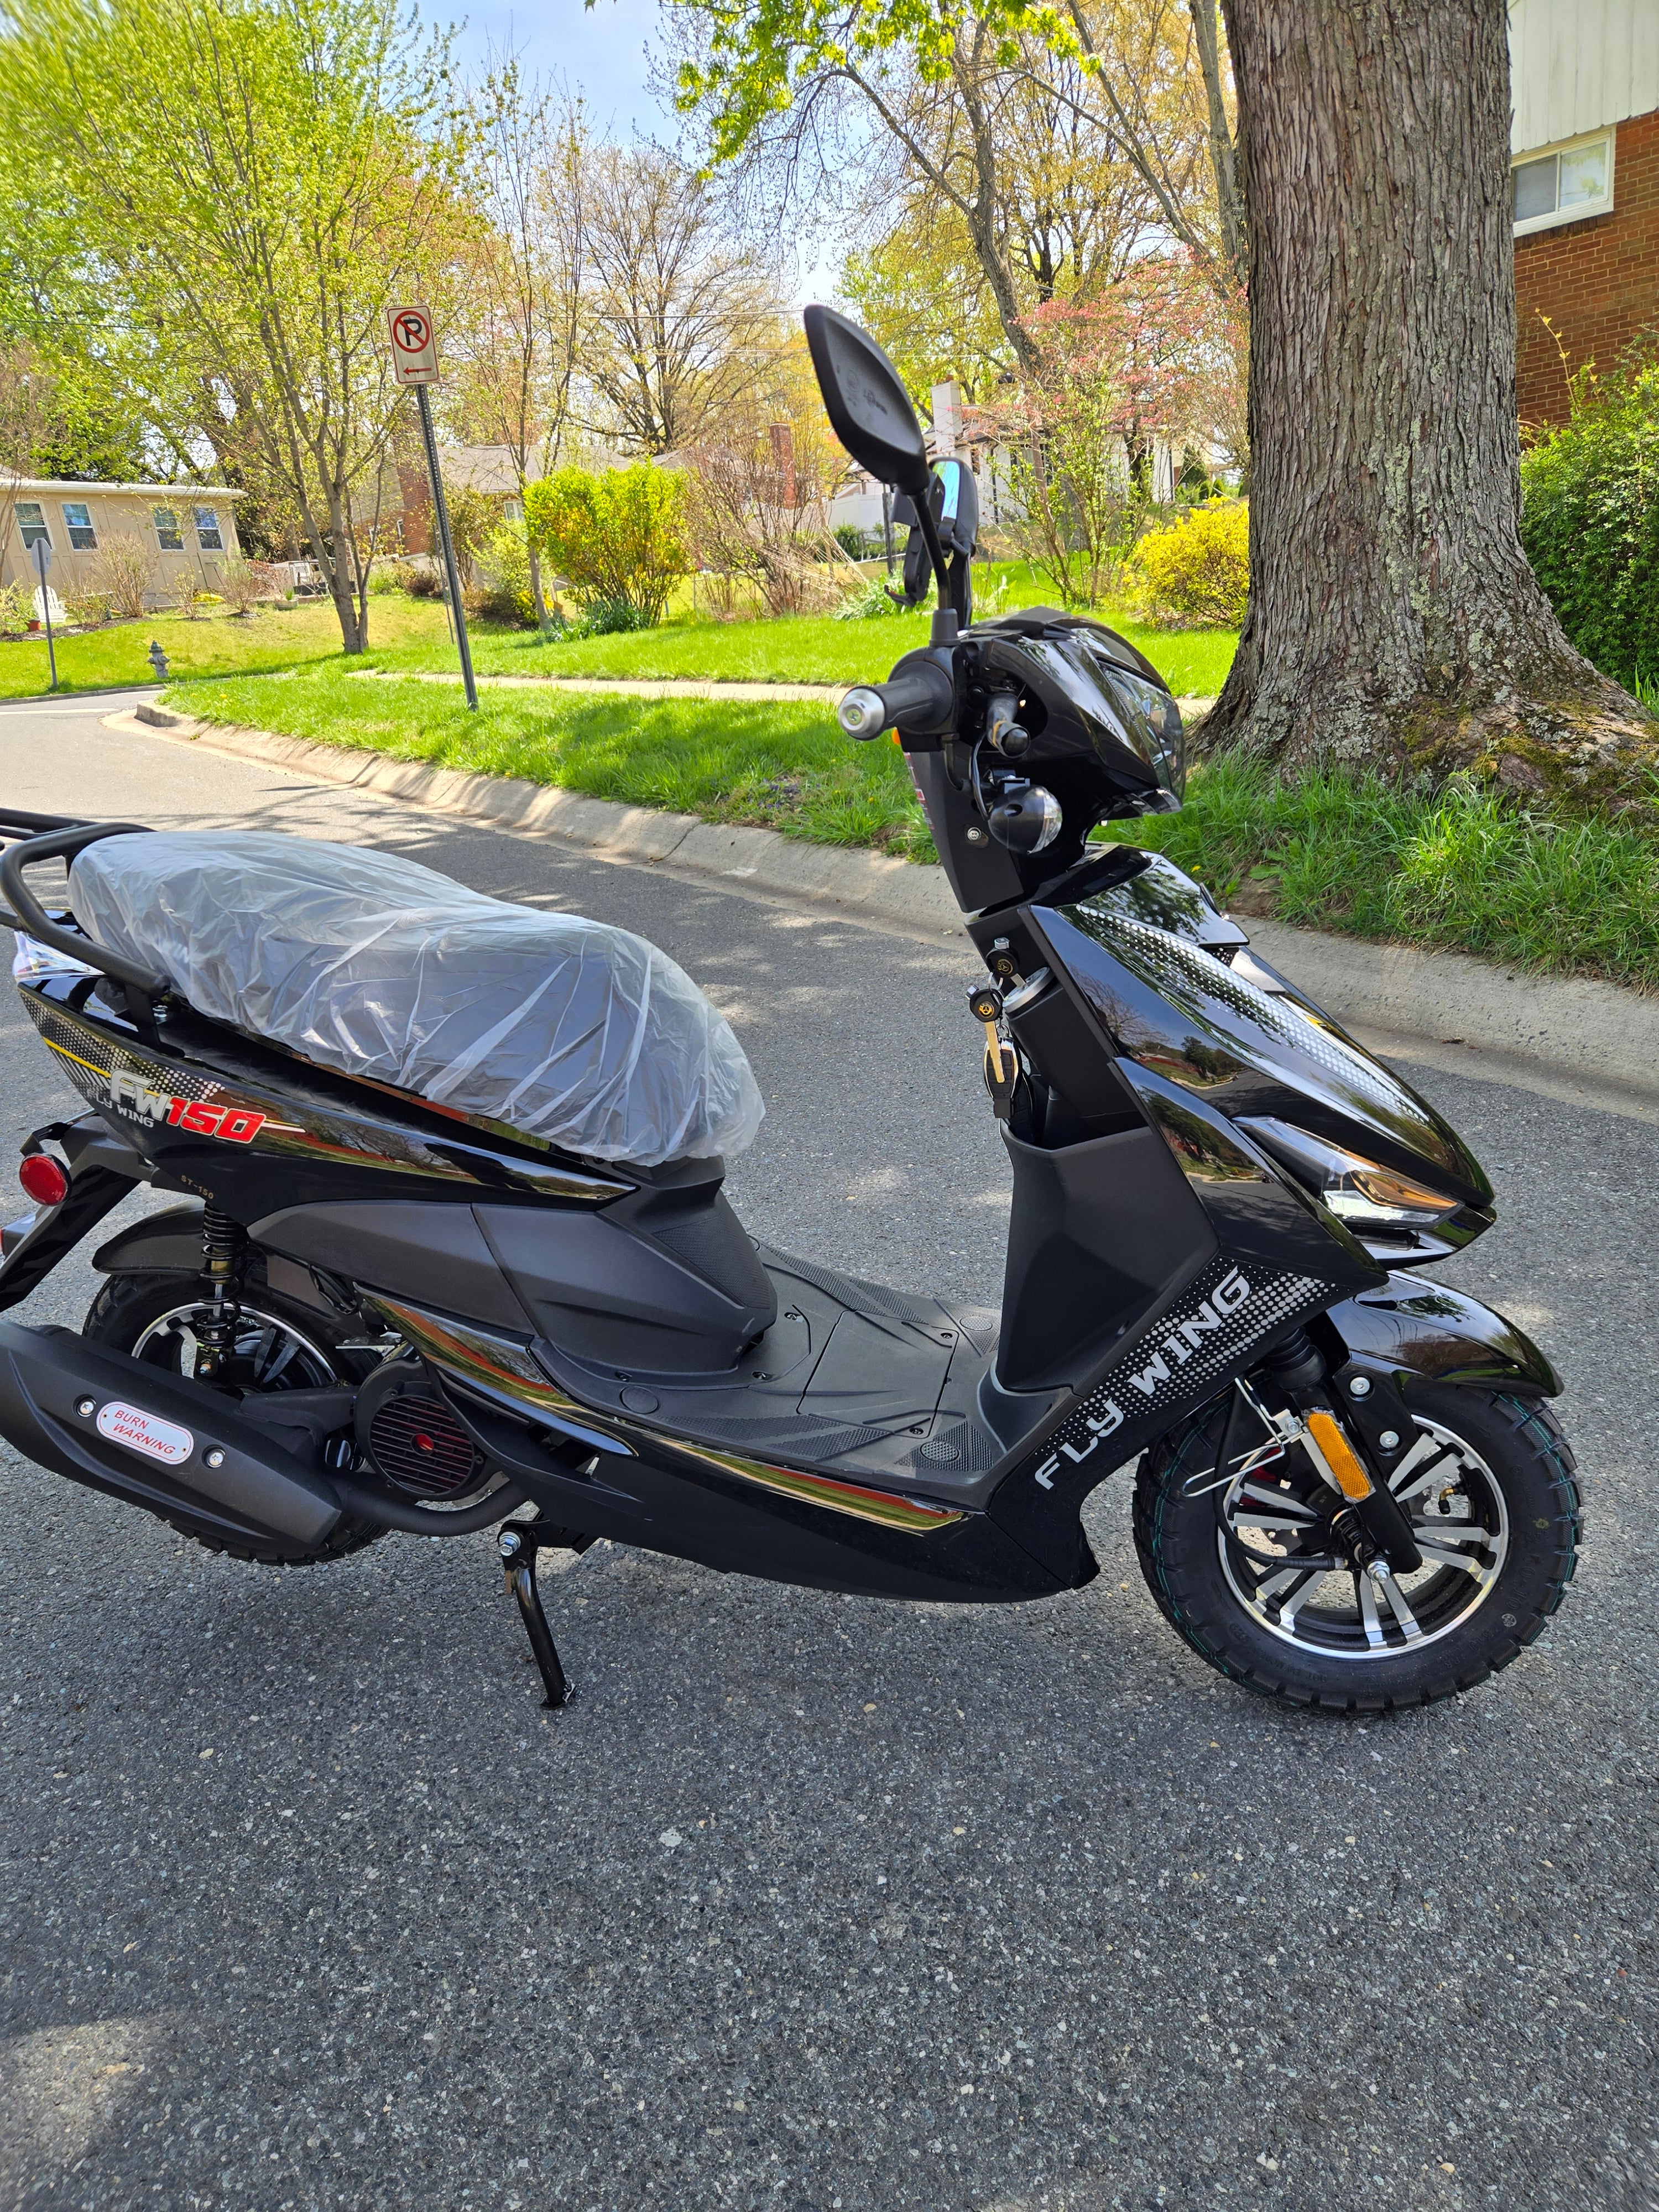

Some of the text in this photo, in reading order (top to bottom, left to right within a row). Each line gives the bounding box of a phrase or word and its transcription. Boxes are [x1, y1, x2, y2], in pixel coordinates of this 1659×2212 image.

[403, 319, 422, 346] P
[87, 1089, 155, 1128] FLY WING
[181, 1175, 215, 1200] ST-150
[1035, 1266, 1251, 1490] FLY WING
[114, 1410, 149, 1430] BURN
[113, 1423, 176, 1454] WARNING
